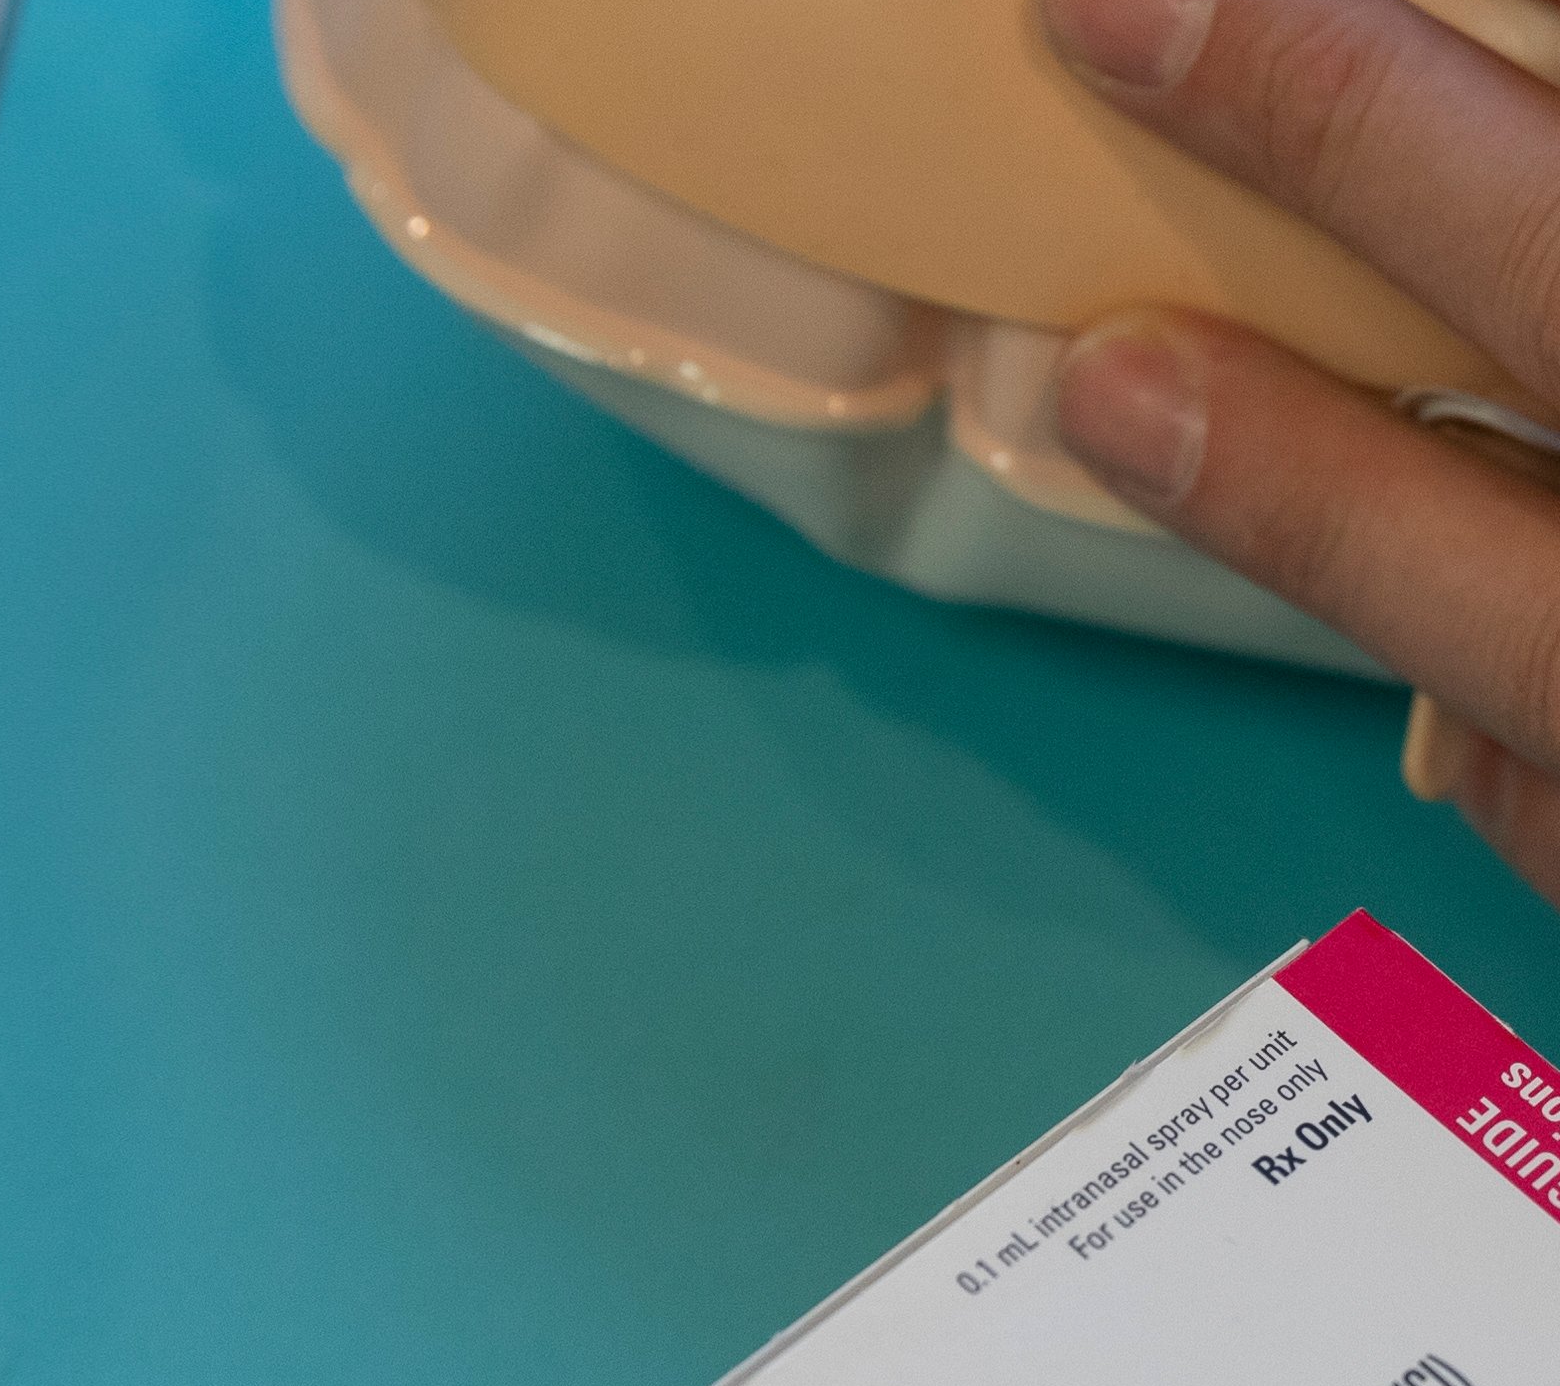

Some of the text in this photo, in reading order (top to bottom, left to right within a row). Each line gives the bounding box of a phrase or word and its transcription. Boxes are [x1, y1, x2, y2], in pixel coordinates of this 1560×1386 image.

[955, 1030, 1298, 1296] 0.1 mL intranasal spray per unit
[1067, 1059, 1329, 1260] For use in the nose only
[1251, 1094, 1373, 1186] Rx Only
